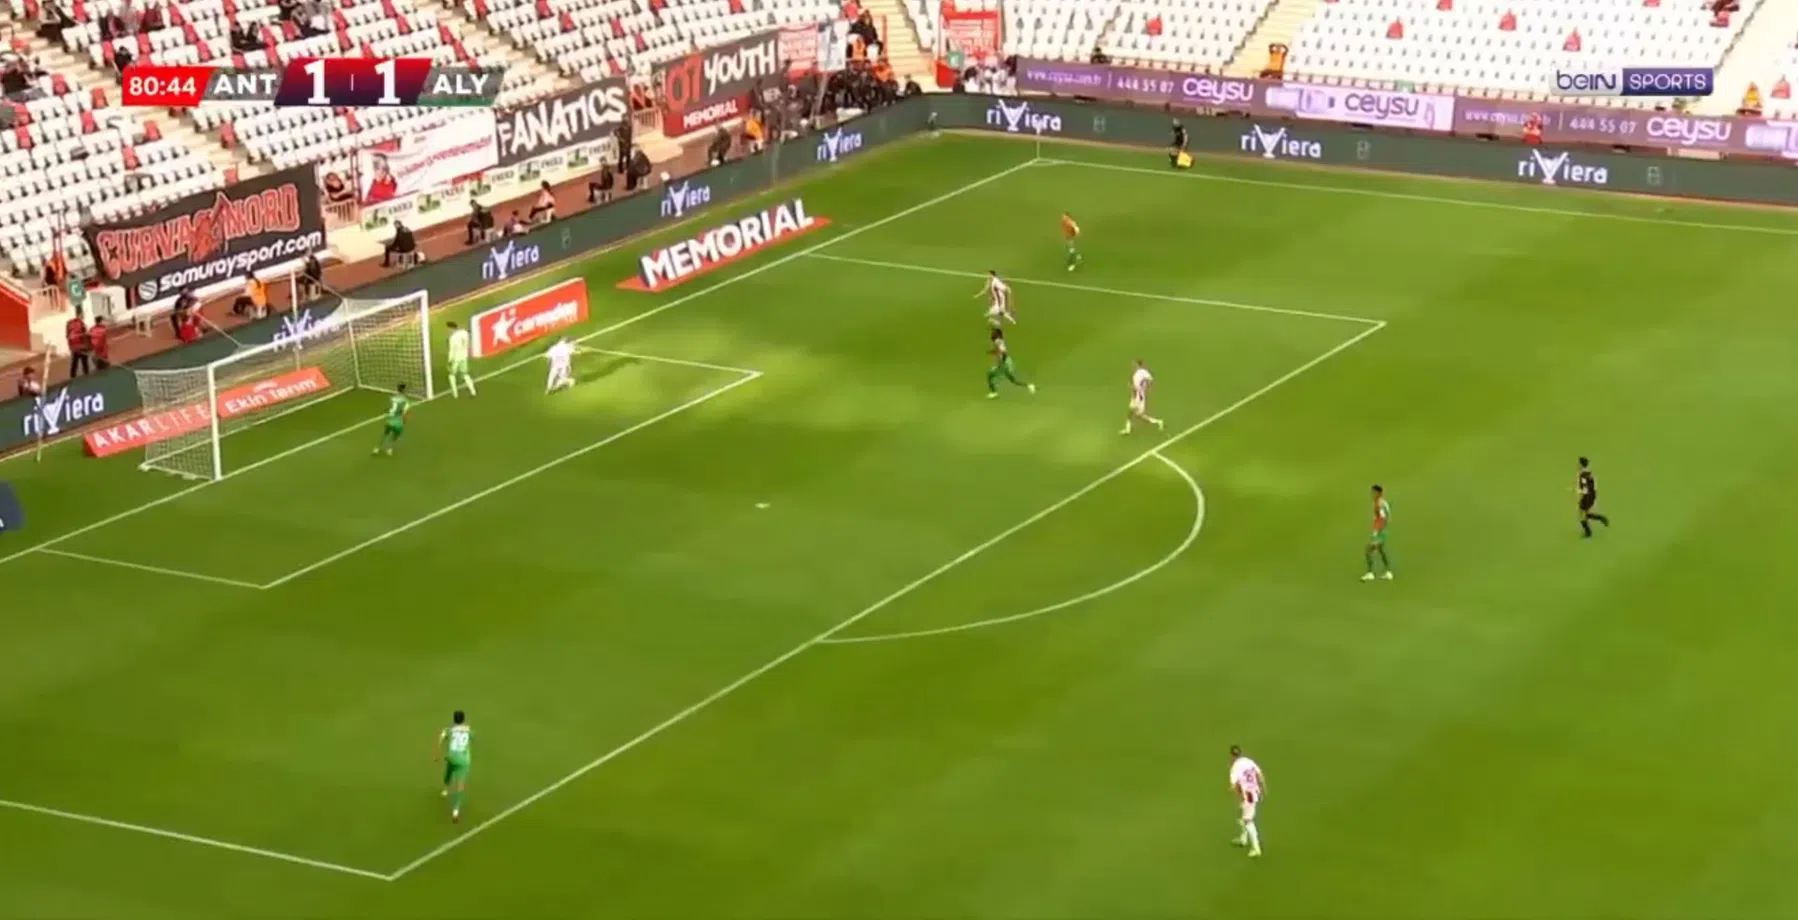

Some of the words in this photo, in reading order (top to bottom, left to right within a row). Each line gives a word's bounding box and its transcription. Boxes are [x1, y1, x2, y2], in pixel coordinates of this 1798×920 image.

[704, 39, 776, 97] YOUTH
[1182, 77, 1254, 104] ceysu
[1344, 92, 1420, 120] ceysu
[498, 85, 628, 158] FANATICS
[682, 99, 738, 129] MEMORIAL
[1569, 116, 1595, 131] 444
[1600, 118, 1616, 133] 55
[1619, 120, 1638, 134] 07
[1646, 116, 1732, 146] ceysu
[223, 185, 300, 240] NORD
[159, 230, 322, 292] samuraysport.com
[639, 198, 815, 288] MEMORIAL
[224, 394, 269, 415] Ekin
